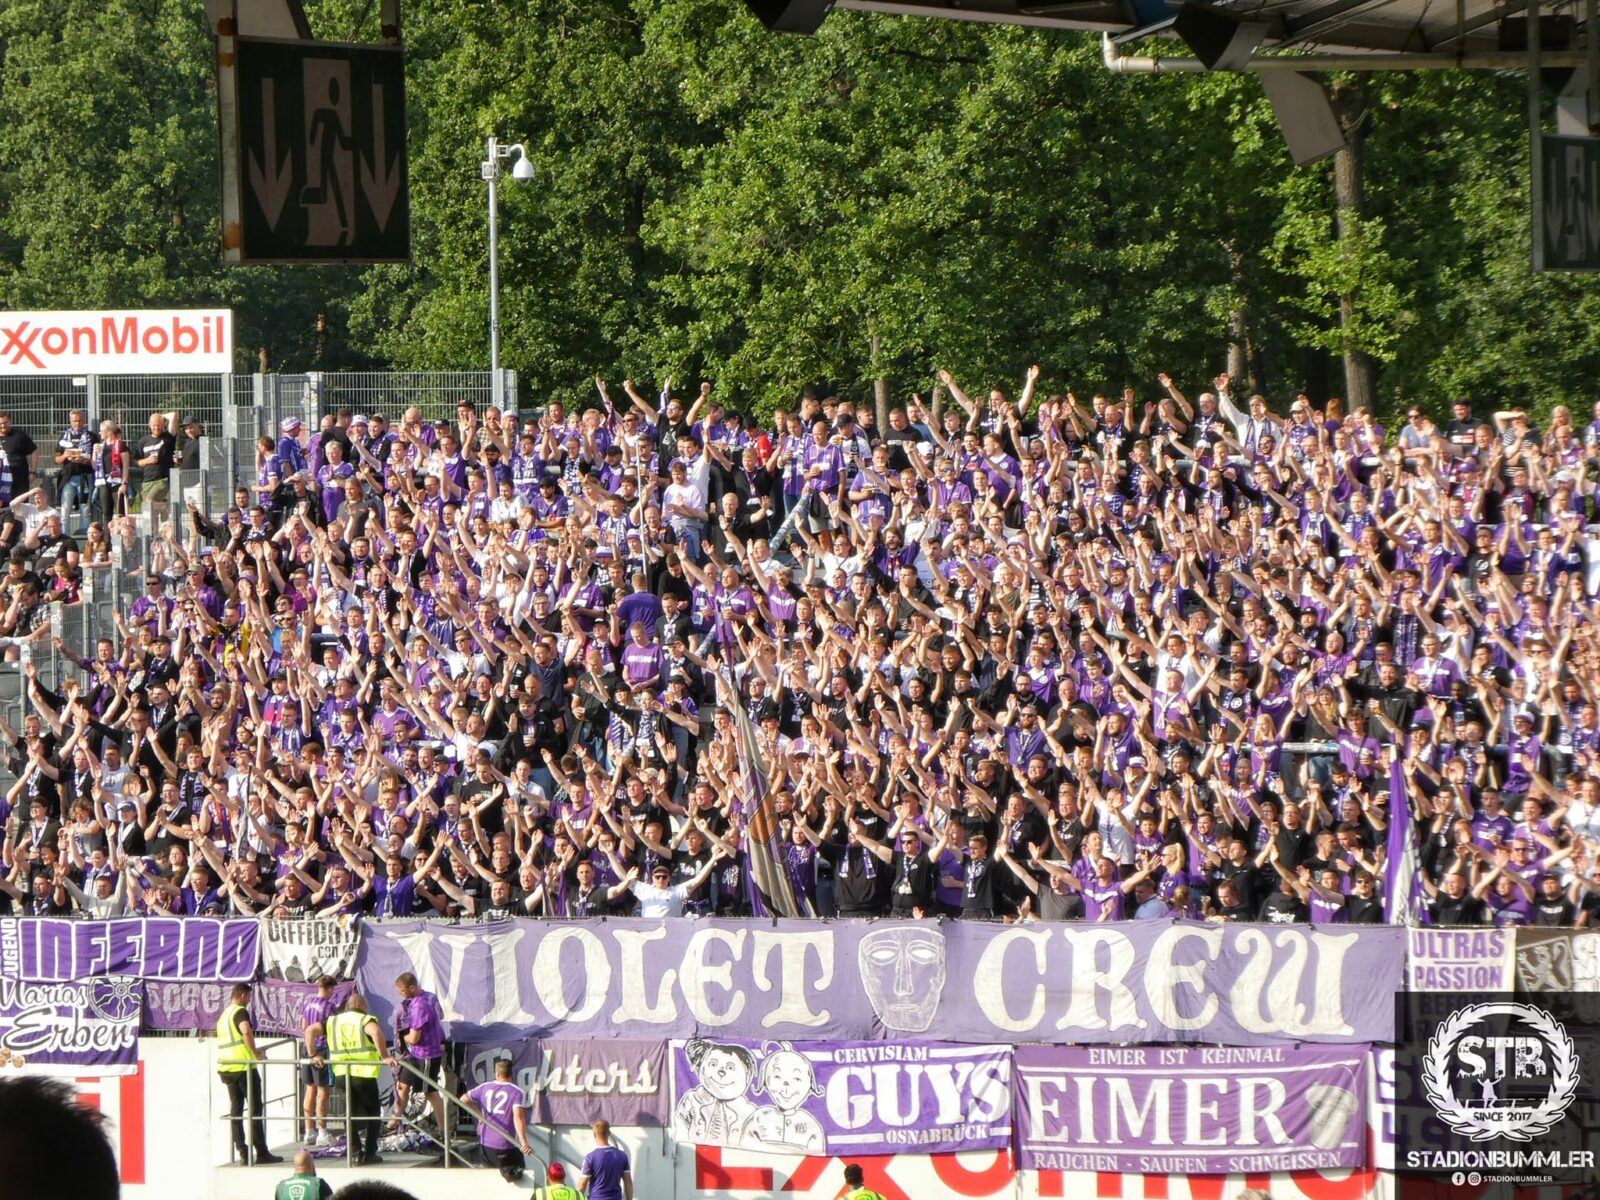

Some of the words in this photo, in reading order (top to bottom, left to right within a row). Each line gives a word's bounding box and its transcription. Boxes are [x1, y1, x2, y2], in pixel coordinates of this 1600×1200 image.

[0, 316, 224, 369] xxonMobil
[18, 917, 261, 982] INFERNO
[1413, 930, 1505, 959] ULTRAS
[386, 925, 834, 1029] VIOLET
[974, 925, 1359, 1036] CREW
[1414, 965, 1504, 989] PASSION
[3, 1005, 135, 1054] Erben
[834, 1045, 928, 1064] CERVISIAM
[1088, 1048, 1147, 1065] EIMER
[1159, 1049, 1188, 1065] IST
[1201, 1047, 1285, 1064] KEINMAL
[485, 1088, 509, 1115] 12
[826, 1059, 1010, 1129] GUYS
[1023, 1076, 1295, 1145] EIMER
[886, 1123, 988, 1144] OSNABRÜCK
[1033, 1152, 1118, 1170] RAUCHEN
[1140, 1156, 1207, 1174] SAUFEN
[1229, 1152, 1342, 1172] SCHMEISSEN
